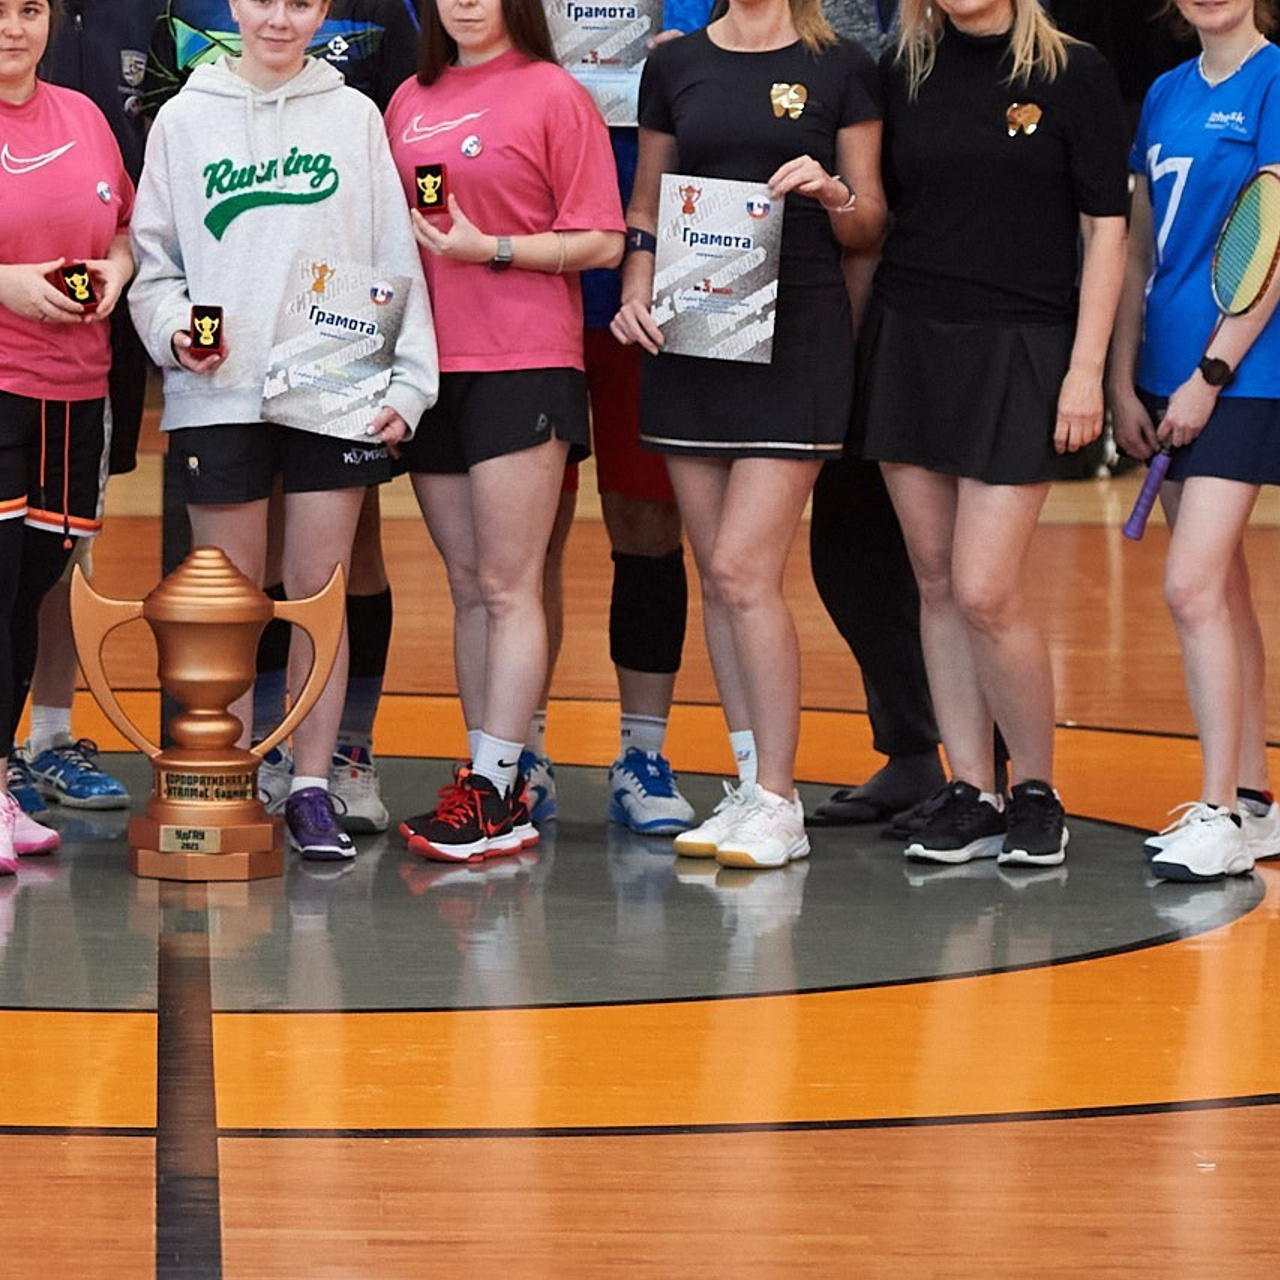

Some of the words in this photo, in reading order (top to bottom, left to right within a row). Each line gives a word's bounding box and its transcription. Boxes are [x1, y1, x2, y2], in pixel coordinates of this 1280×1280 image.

[566, 3, 637, 21] Грамота
[682, 227, 752, 249] Грамота
[308, 304, 376, 336] Грамота
